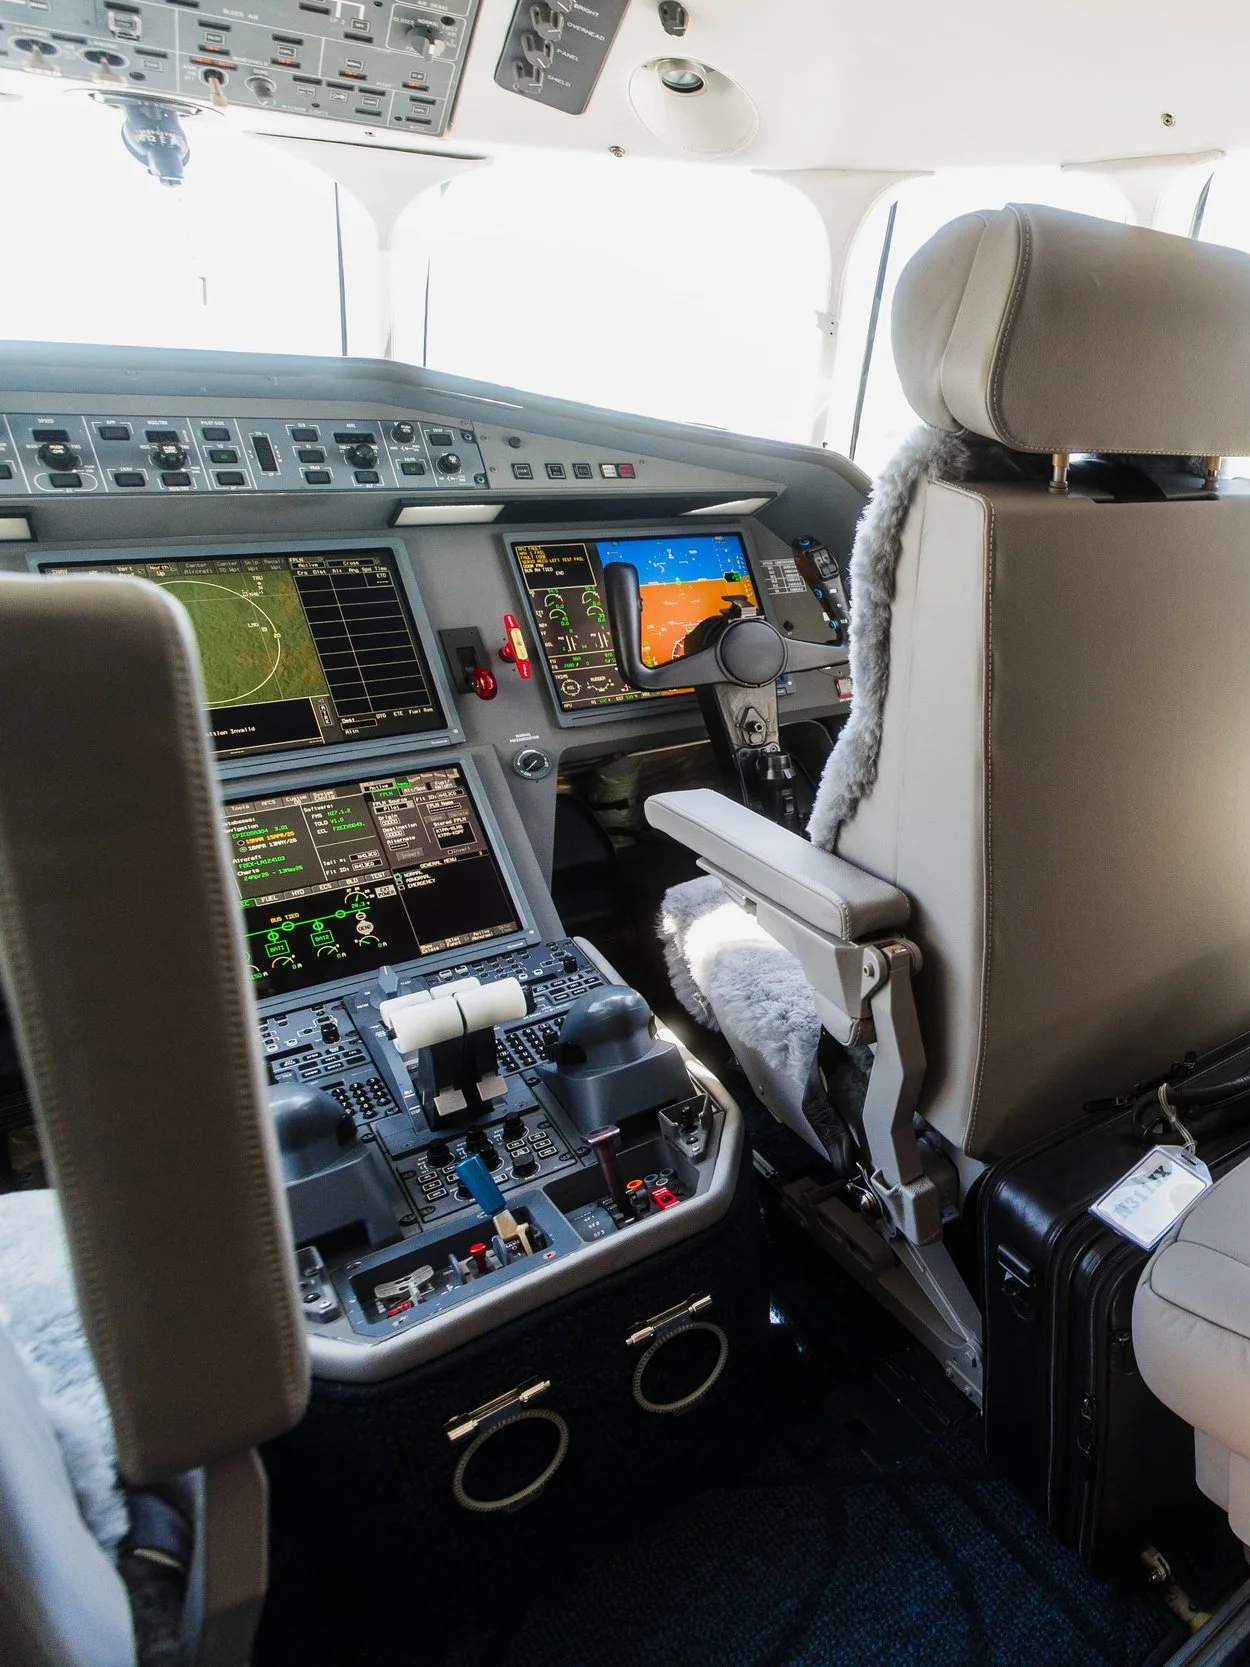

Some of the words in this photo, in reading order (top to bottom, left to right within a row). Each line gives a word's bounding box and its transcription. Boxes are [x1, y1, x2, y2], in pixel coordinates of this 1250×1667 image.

[573, 3, 600, 18] BRIGHT
[393, 16, 415, 25] CLOSED
[567, 21, 605, 41] OVERHEAD
[556, 48, 579, 62] PANEL
[548, 74, 571, 87] SHIELD
[303, 804, 334, 813] Software:
[382, 822, 417, 832] Destination
[387, 836, 416, 844] Alternate
[232, 855, 262, 864] Aircraft
[420, 860, 441, 868] GENERAL
[403, 870, 424, 878] NORMAL
[407, 878, 436, 889] EMERGENCY
[261, 895, 279, 903] FUEL
[588, 1221, 600, 1229] SF2
[593, 1230, 605, 1238] SF3
